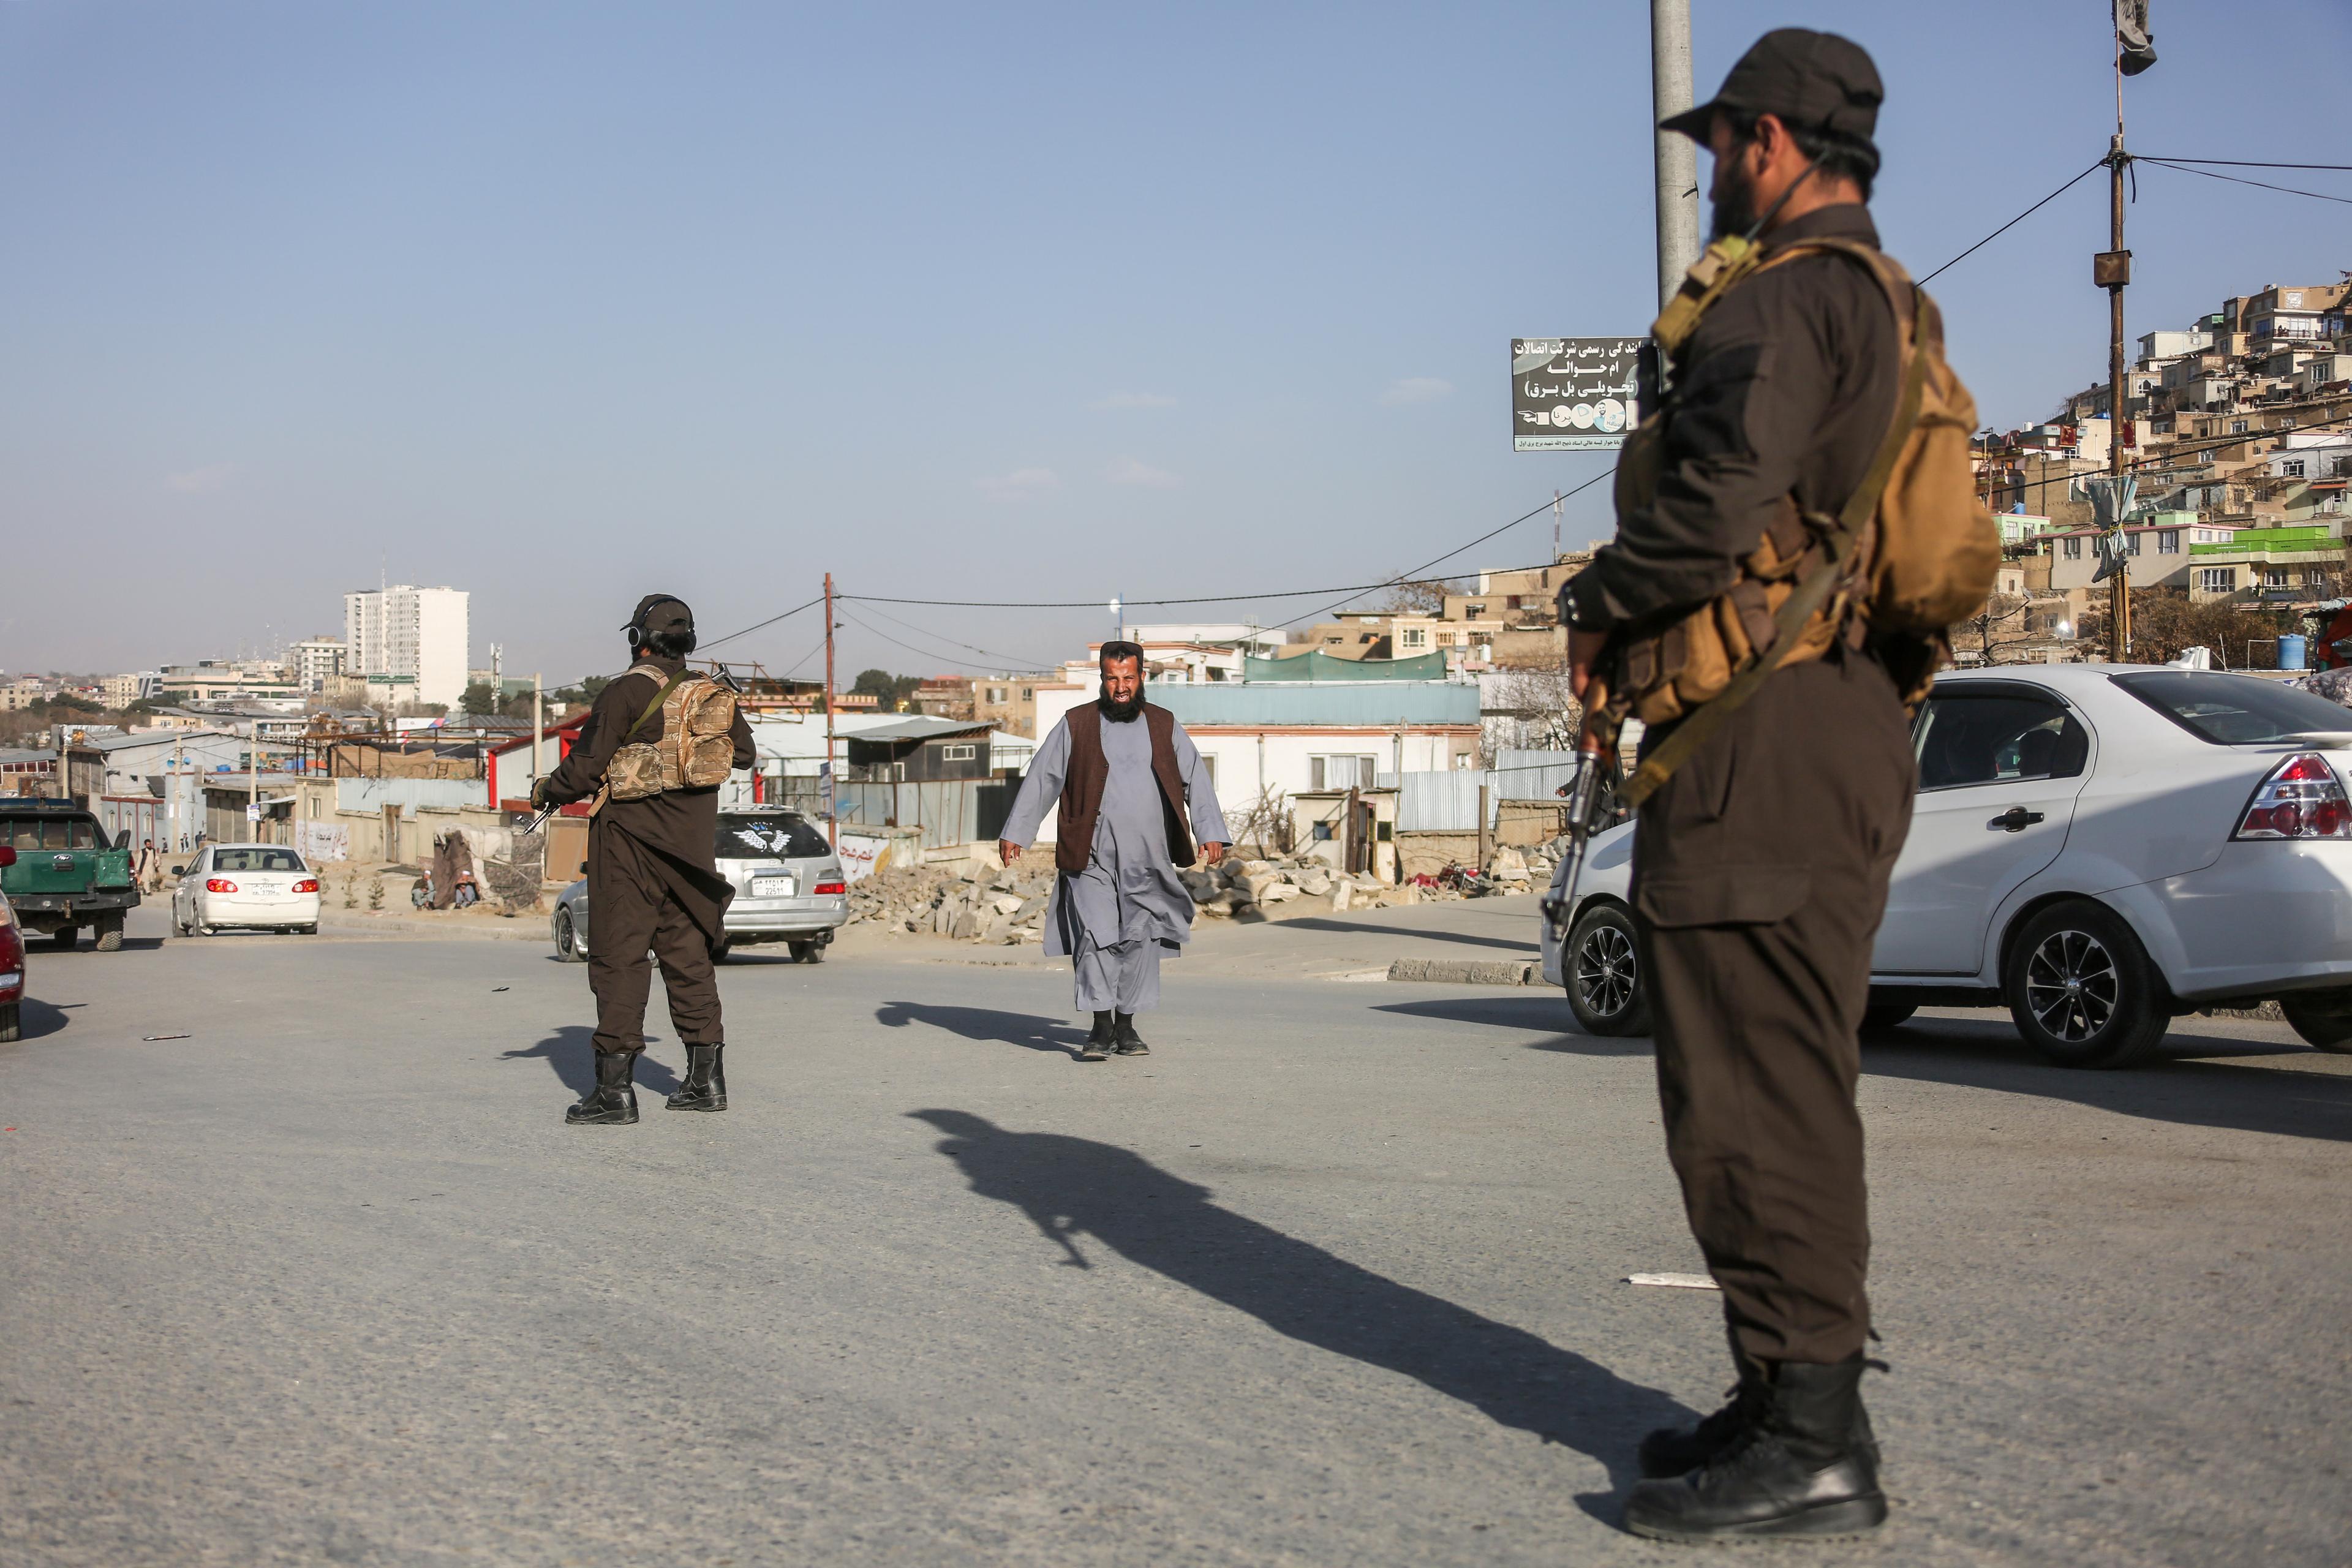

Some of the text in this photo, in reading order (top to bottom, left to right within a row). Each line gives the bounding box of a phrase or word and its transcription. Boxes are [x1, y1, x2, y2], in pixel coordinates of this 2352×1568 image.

[1515, 342, 1548, 355] اتصالات
[1550, 342, 1577, 358] شرکت
[1578, 344, 1605, 358] رسمی
[1609, 361, 1619, 377] ام
[1561, 380, 1575, 398] بل
